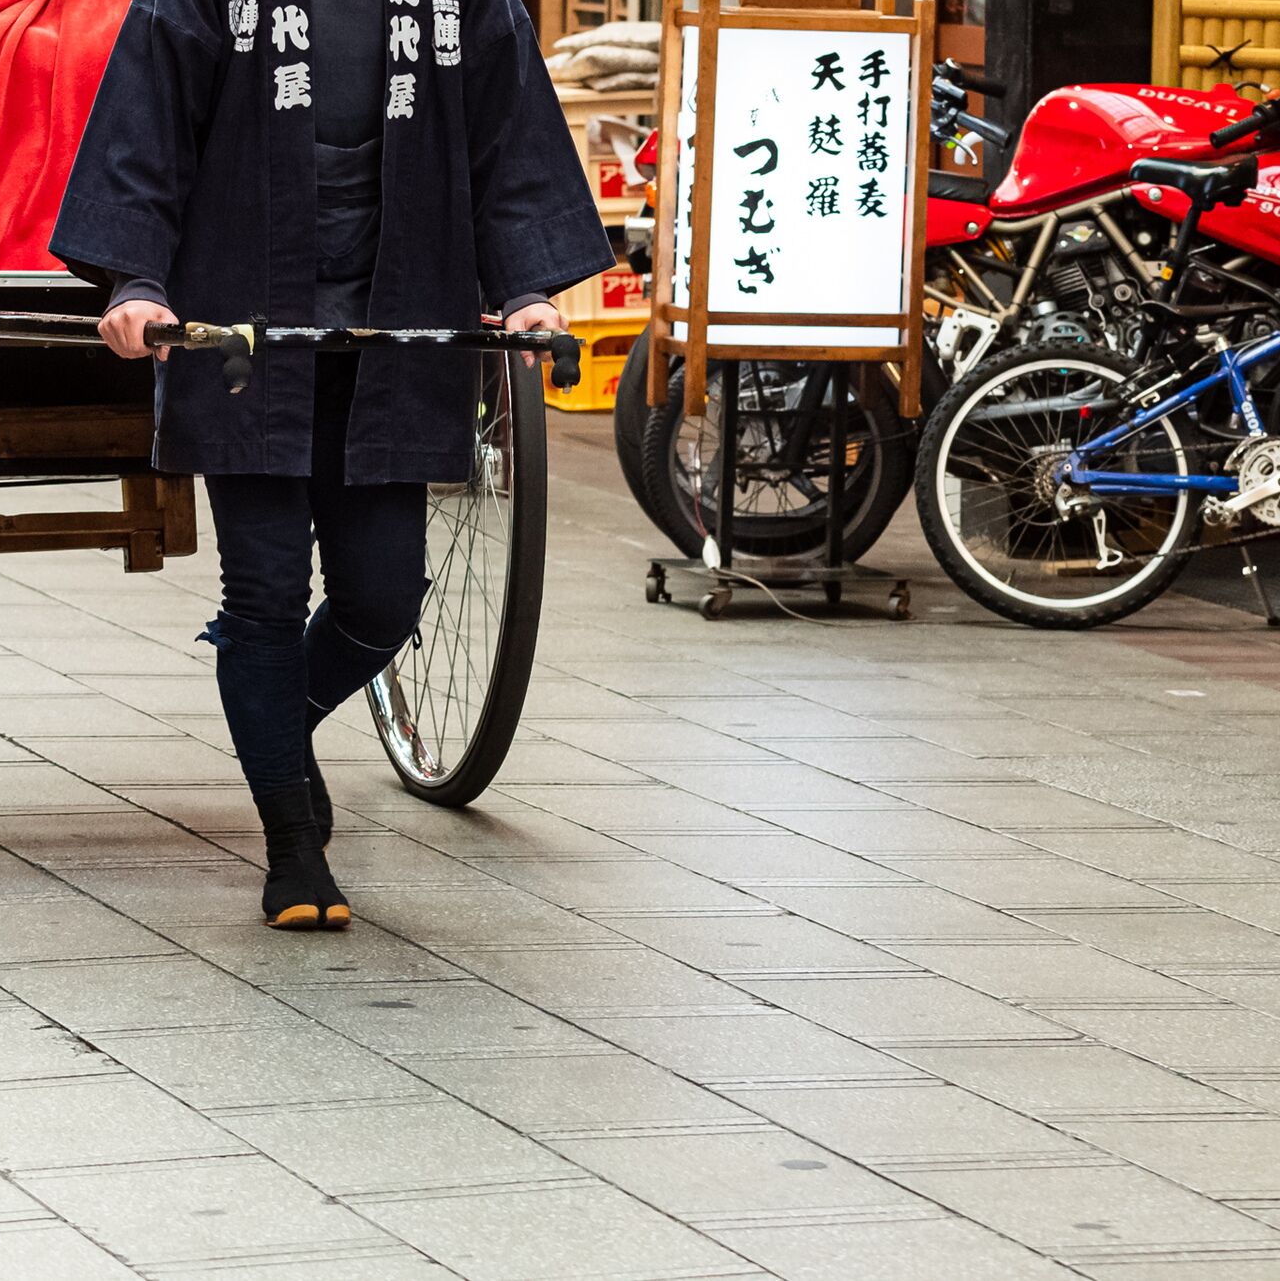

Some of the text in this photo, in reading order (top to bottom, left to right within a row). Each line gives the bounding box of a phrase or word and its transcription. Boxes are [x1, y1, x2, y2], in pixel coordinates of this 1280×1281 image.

[856, 49, 892, 218] 手打蕎麦
[1137, 87, 1238, 117] DUCATI
[733, 137, 782, 295] つむぎ
